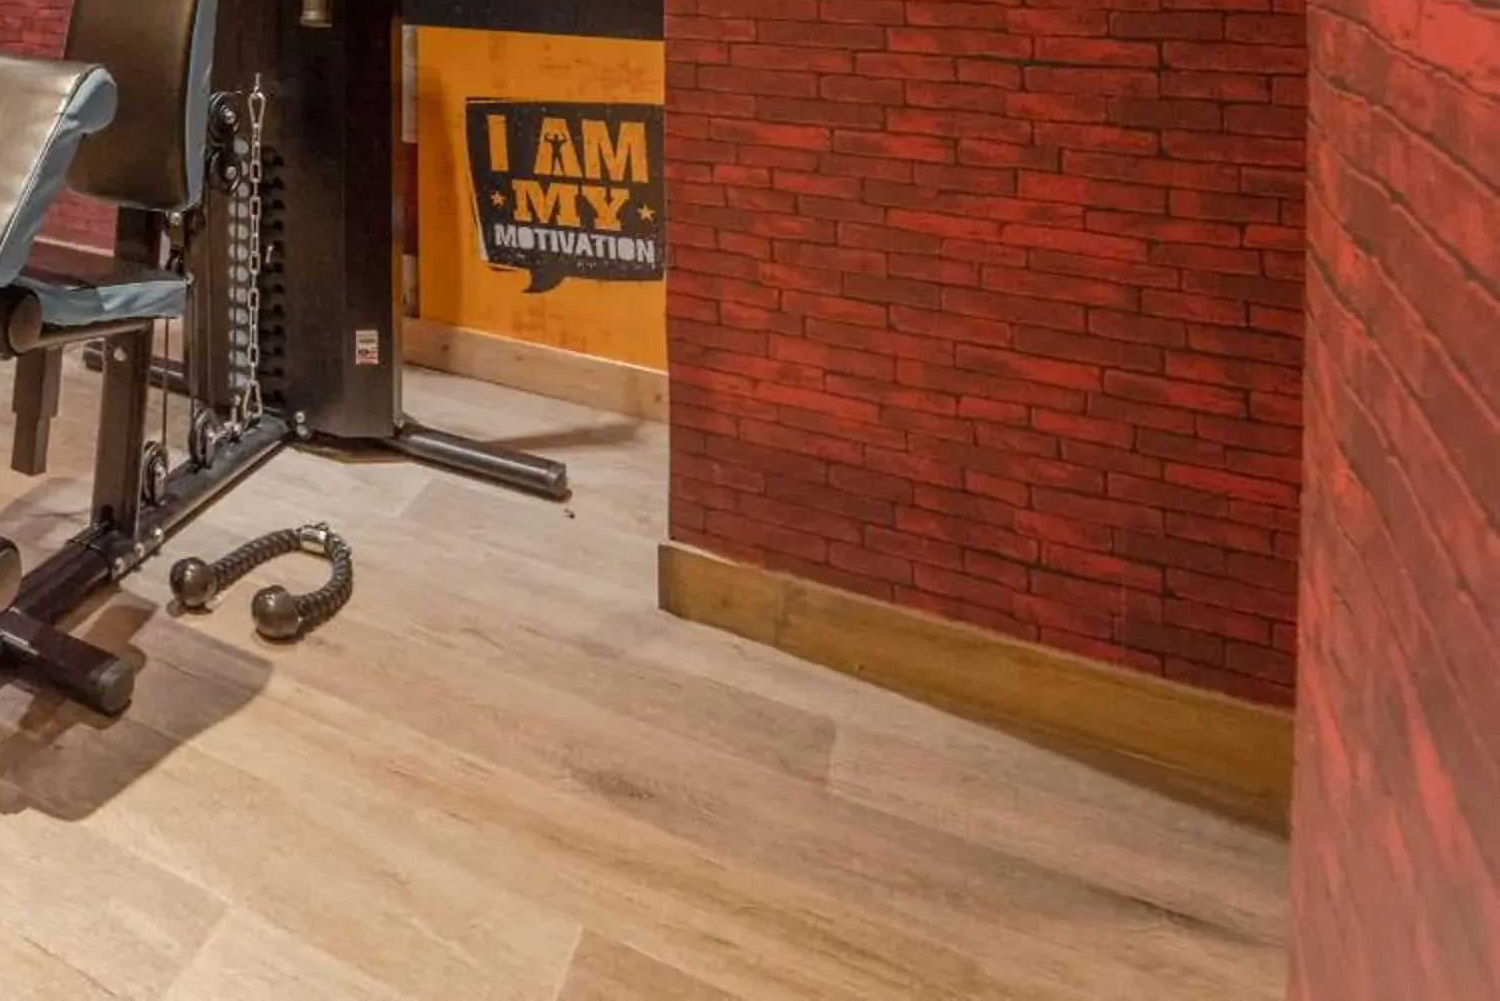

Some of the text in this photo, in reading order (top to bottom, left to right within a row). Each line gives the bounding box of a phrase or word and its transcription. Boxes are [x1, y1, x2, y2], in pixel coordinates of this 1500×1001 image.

[487, 114, 649, 184] I AM
[512, 179, 630, 232] MY
[495, 224, 655, 264] MOTIVATION
